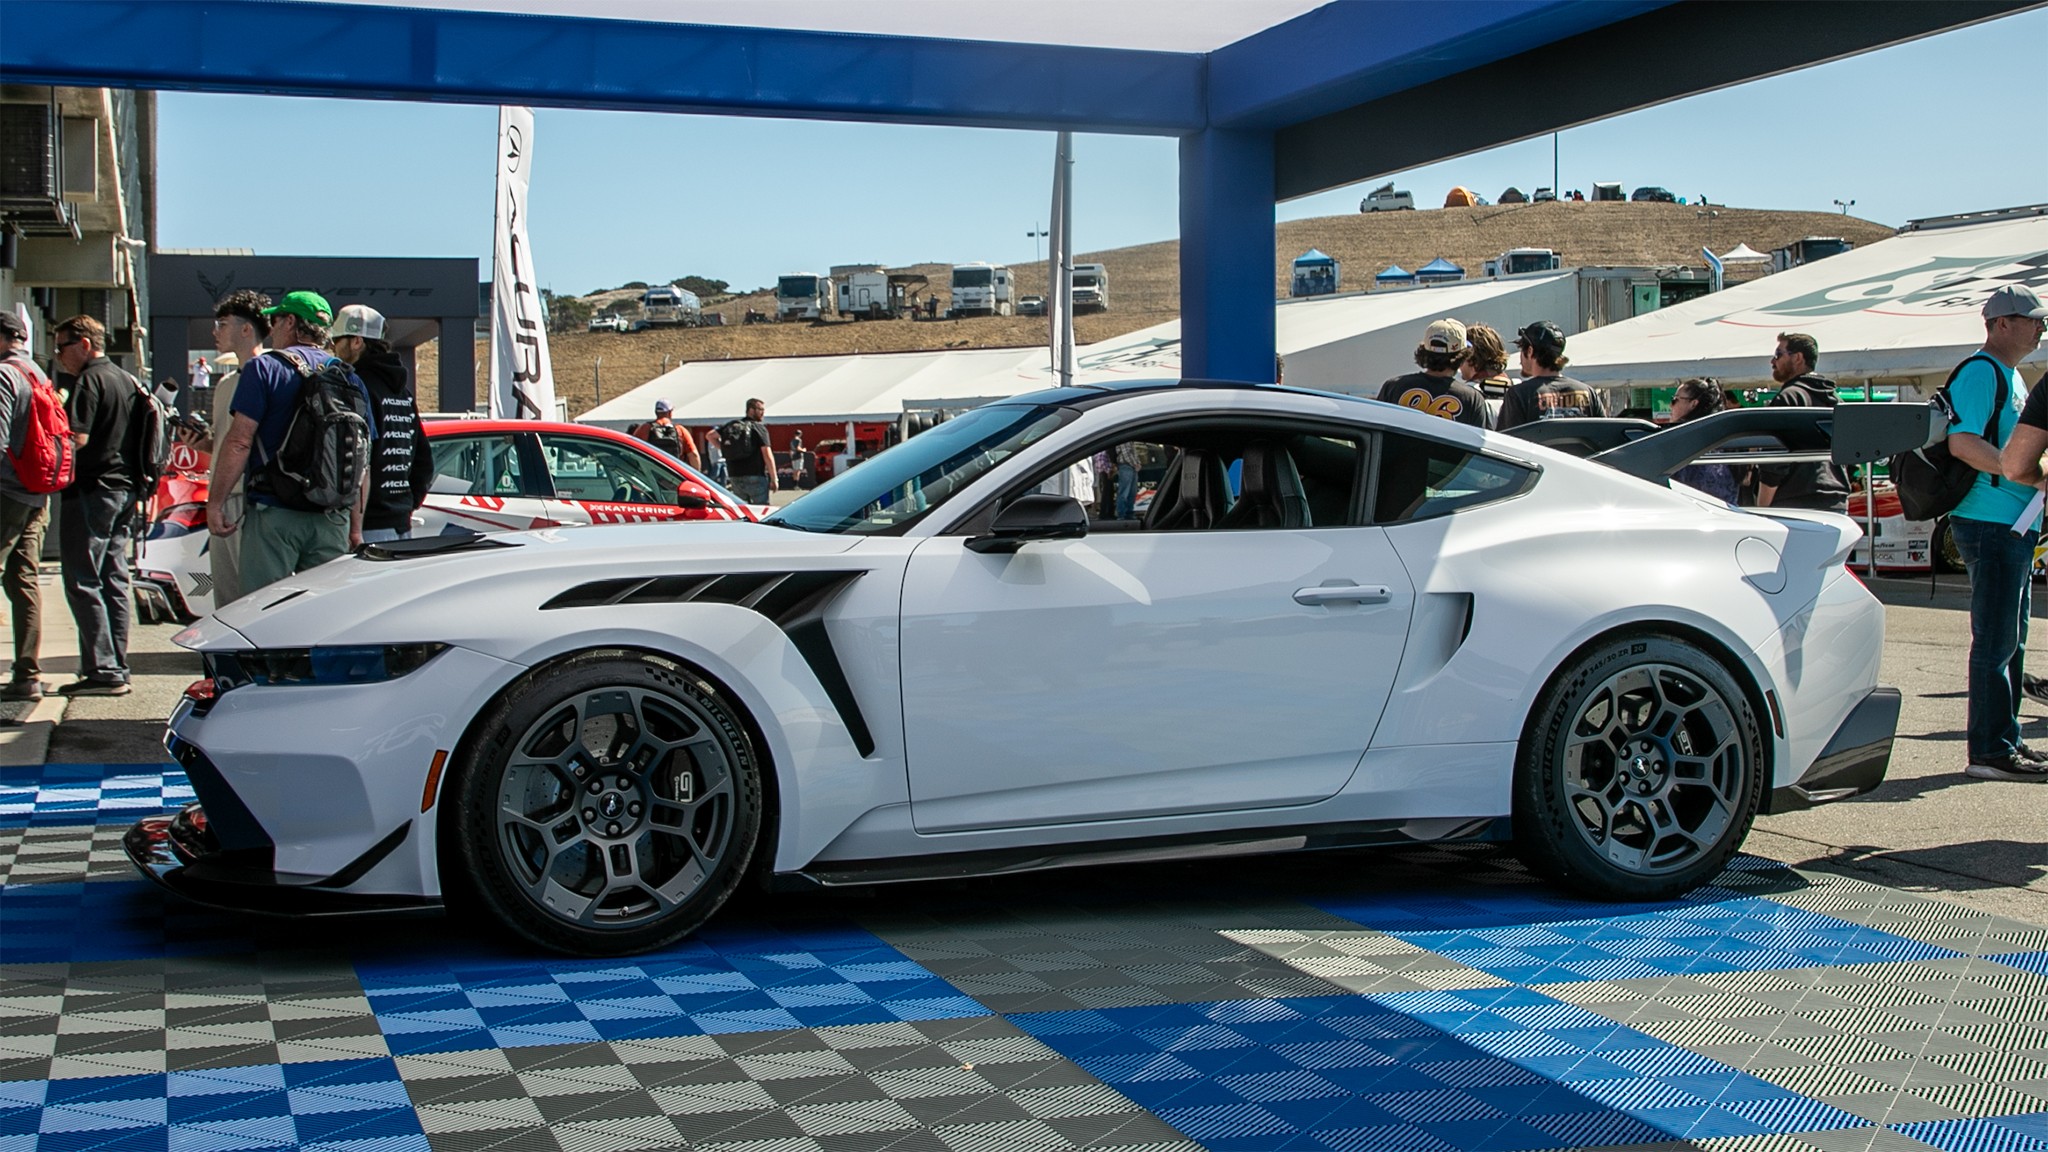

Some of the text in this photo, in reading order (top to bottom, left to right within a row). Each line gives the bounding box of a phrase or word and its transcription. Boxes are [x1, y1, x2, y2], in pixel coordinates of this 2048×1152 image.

[243, 286, 434, 297] OVETTE
[383, 431, 412, 439] McLare
[604, 504, 676, 515] KATHERINE
[700, 698, 749, 766] MICHELIN
[1543, 702, 1567, 782] MICHELIN
